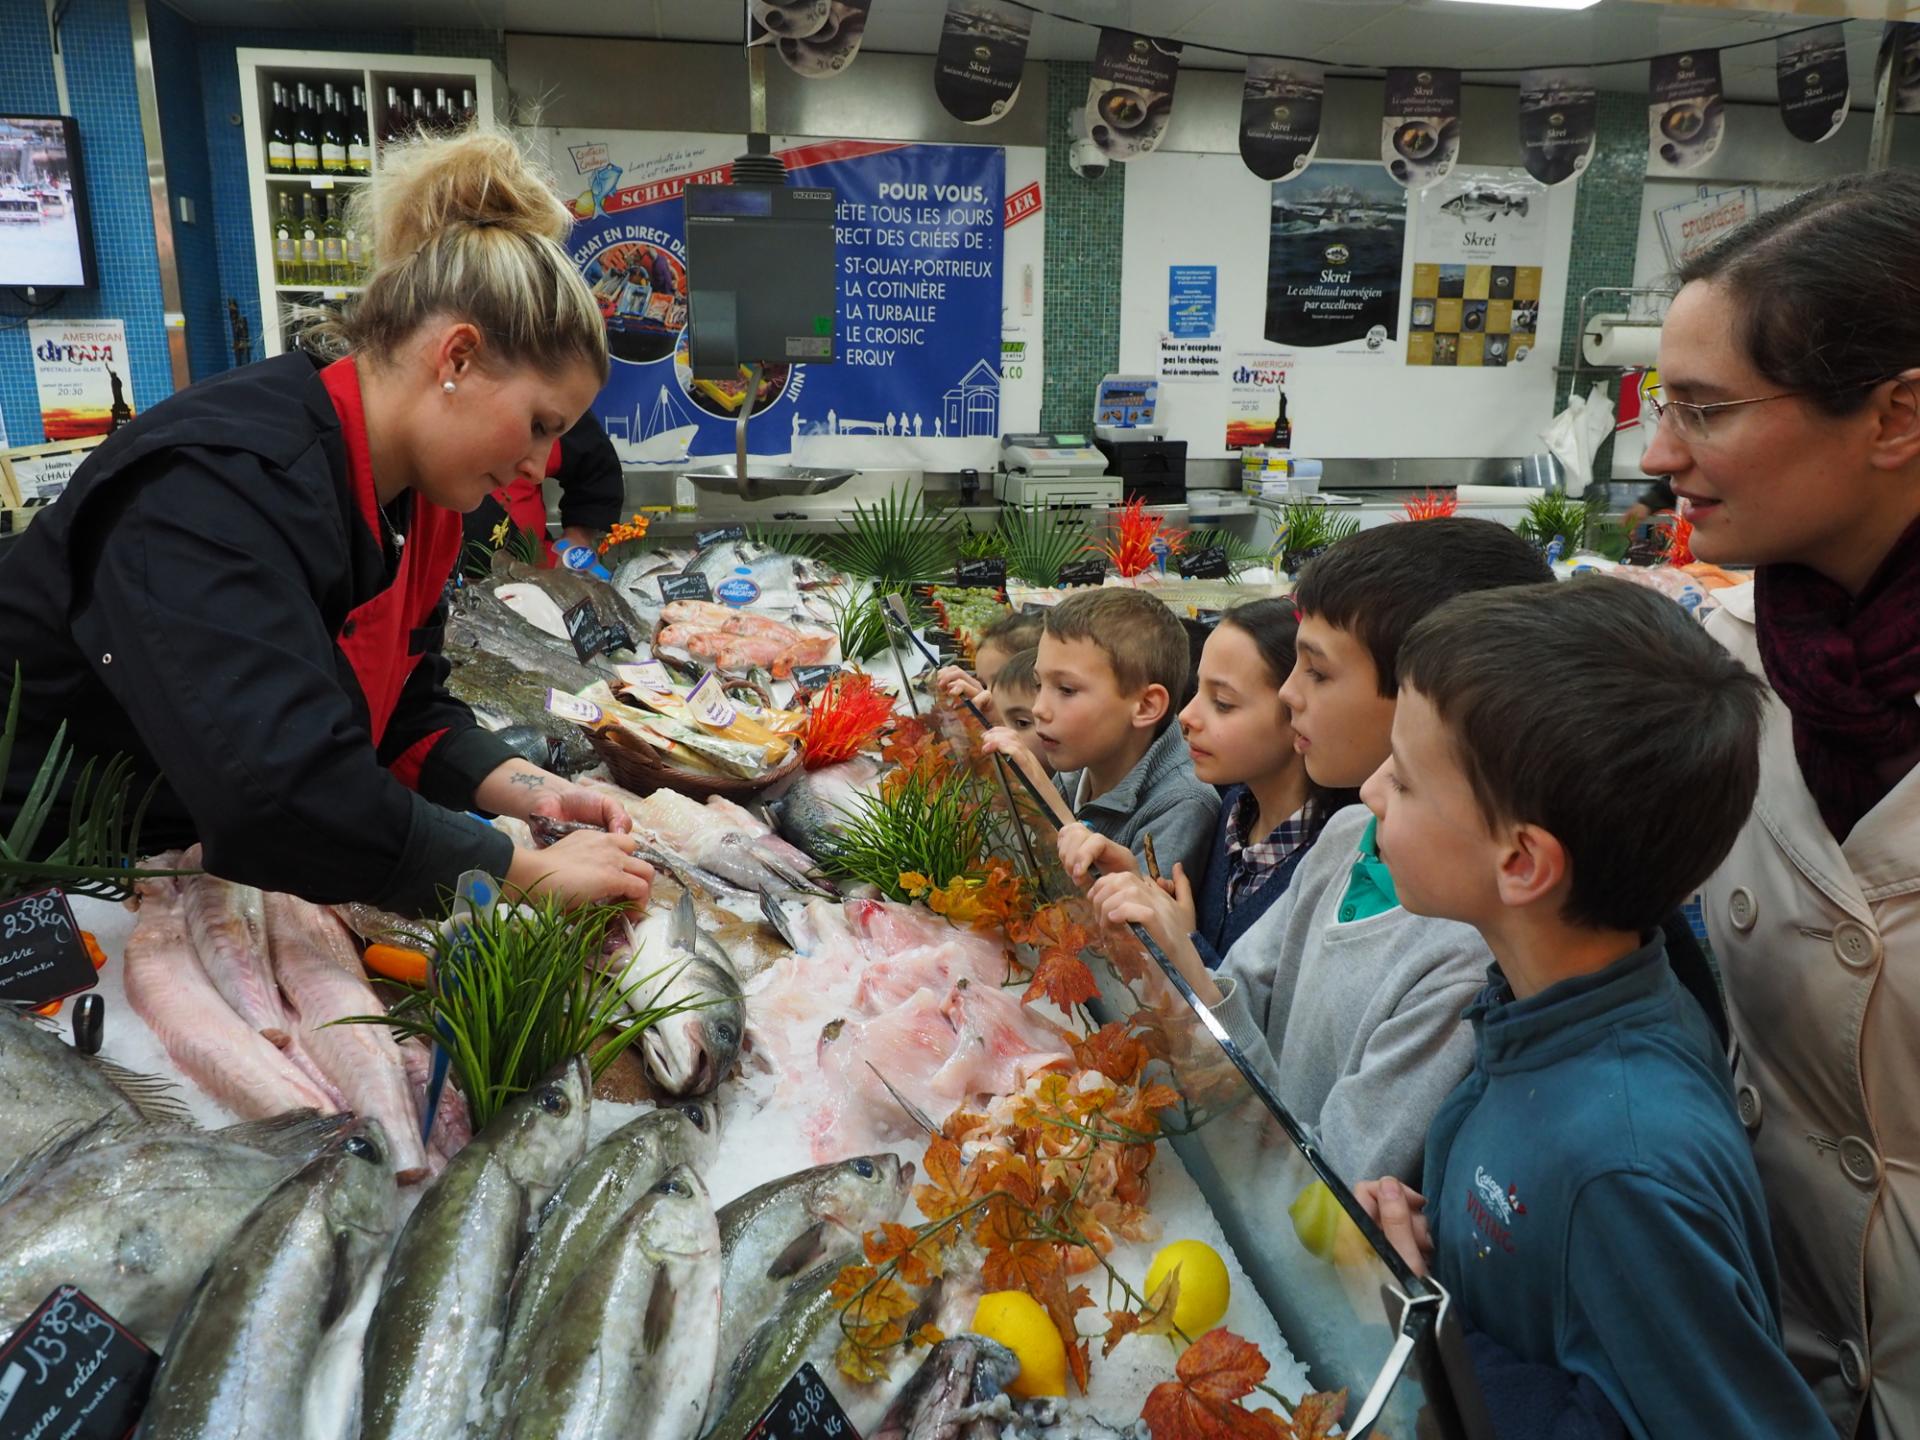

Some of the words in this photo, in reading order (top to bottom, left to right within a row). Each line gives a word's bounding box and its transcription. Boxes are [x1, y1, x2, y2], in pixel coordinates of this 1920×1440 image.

[968, 61, 991, 74] Skrei
[1127, 54, 1149, 66] Skrei
[1413, 86, 1433, 96] Skrei
[1270, 121, 1290, 132] Skrei
[879, 182, 928, 201] POUR
[934, 185, 988, 205] VOUS,
[871, 205, 912, 224] TOUS
[917, 207, 940, 225] LES
[945, 208, 993, 226] JOURS
[603, 227, 622, 244] EN
[626, 225, 671, 246] DIRECT
[877, 229, 904, 246] DES
[910, 227, 959, 248] CRIÉES
[964, 232, 983, 249] DE
[1463, 231, 1496, 247] Skrei
[844, 256, 992, 279] ST-QUAY-PORTRIEUX
[1320, 269, 1351, 283] Skrei
[846, 279, 862, 297] LA
[867, 279, 945, 300] COTINIÈRE
[1287, 285, 1298, 296] Le
[1299, 285, 1339, 297] cabillaud
[1340, 288, 1382, 300] norvégien
[846, 303, 863, 319] LA
[867, 304, 936, 322] TURBALLE
[1303, 300, 1319, 312] par
[1320, 299, 1363, 310] excellence
[62, 332, 122, 343] AMERICAN
[846, 326, 861, 342] LE
[865, 326, 925, 345] CROISIC
[1161, 343, 1178, 351] Nous
[1181, 343, 1221, 352] n'acceptons
[846, 349, 895, 366] ERQUY
[1163, 356, 1176, 364] pas
[1178, 355, 1187, 364] les
[1188, 356, 1219, 365] chèques.
[1252, 360, 1294, 369] AMERICAN
[58, 388, 83, 396] 20:30
[786, 371, 806, 403] NUIT
[65, 1349, 108, 1398] entier
